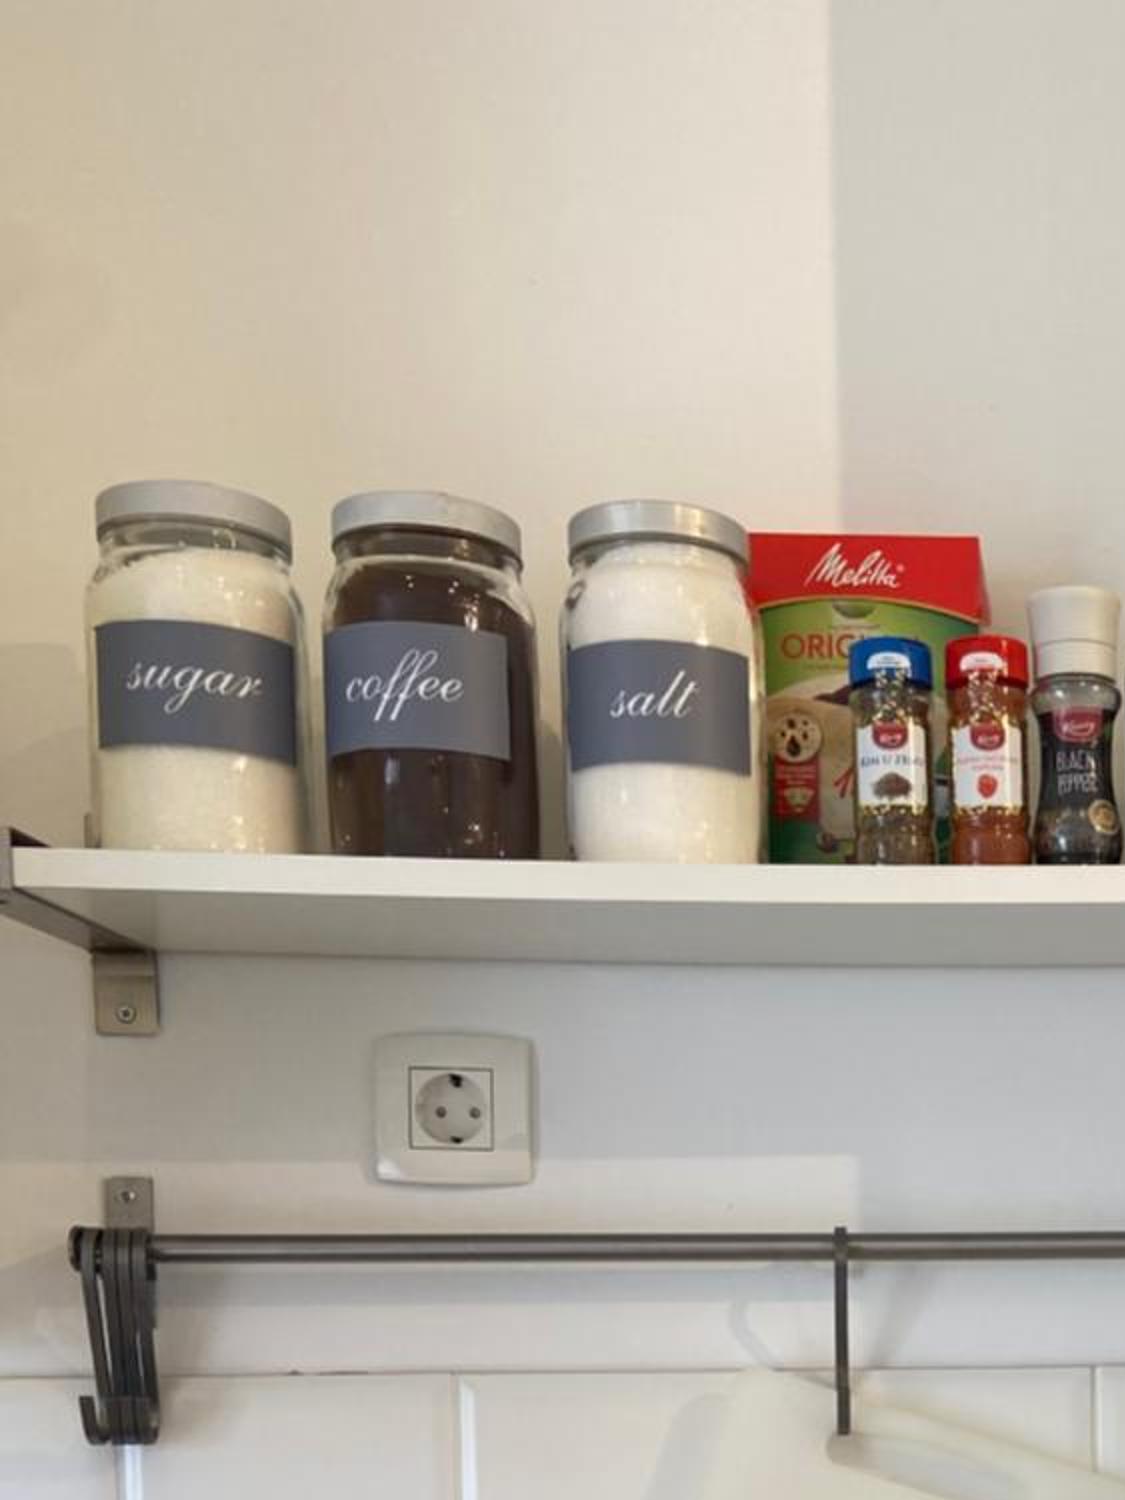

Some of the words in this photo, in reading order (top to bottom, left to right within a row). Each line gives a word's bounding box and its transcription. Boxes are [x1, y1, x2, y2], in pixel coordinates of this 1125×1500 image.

[804, 542, 901, 589] Melitta
[126, 663, 262, 714] sugar
[346, 649, 465, 722] coffee
[609, 671, 697, 718] salt
